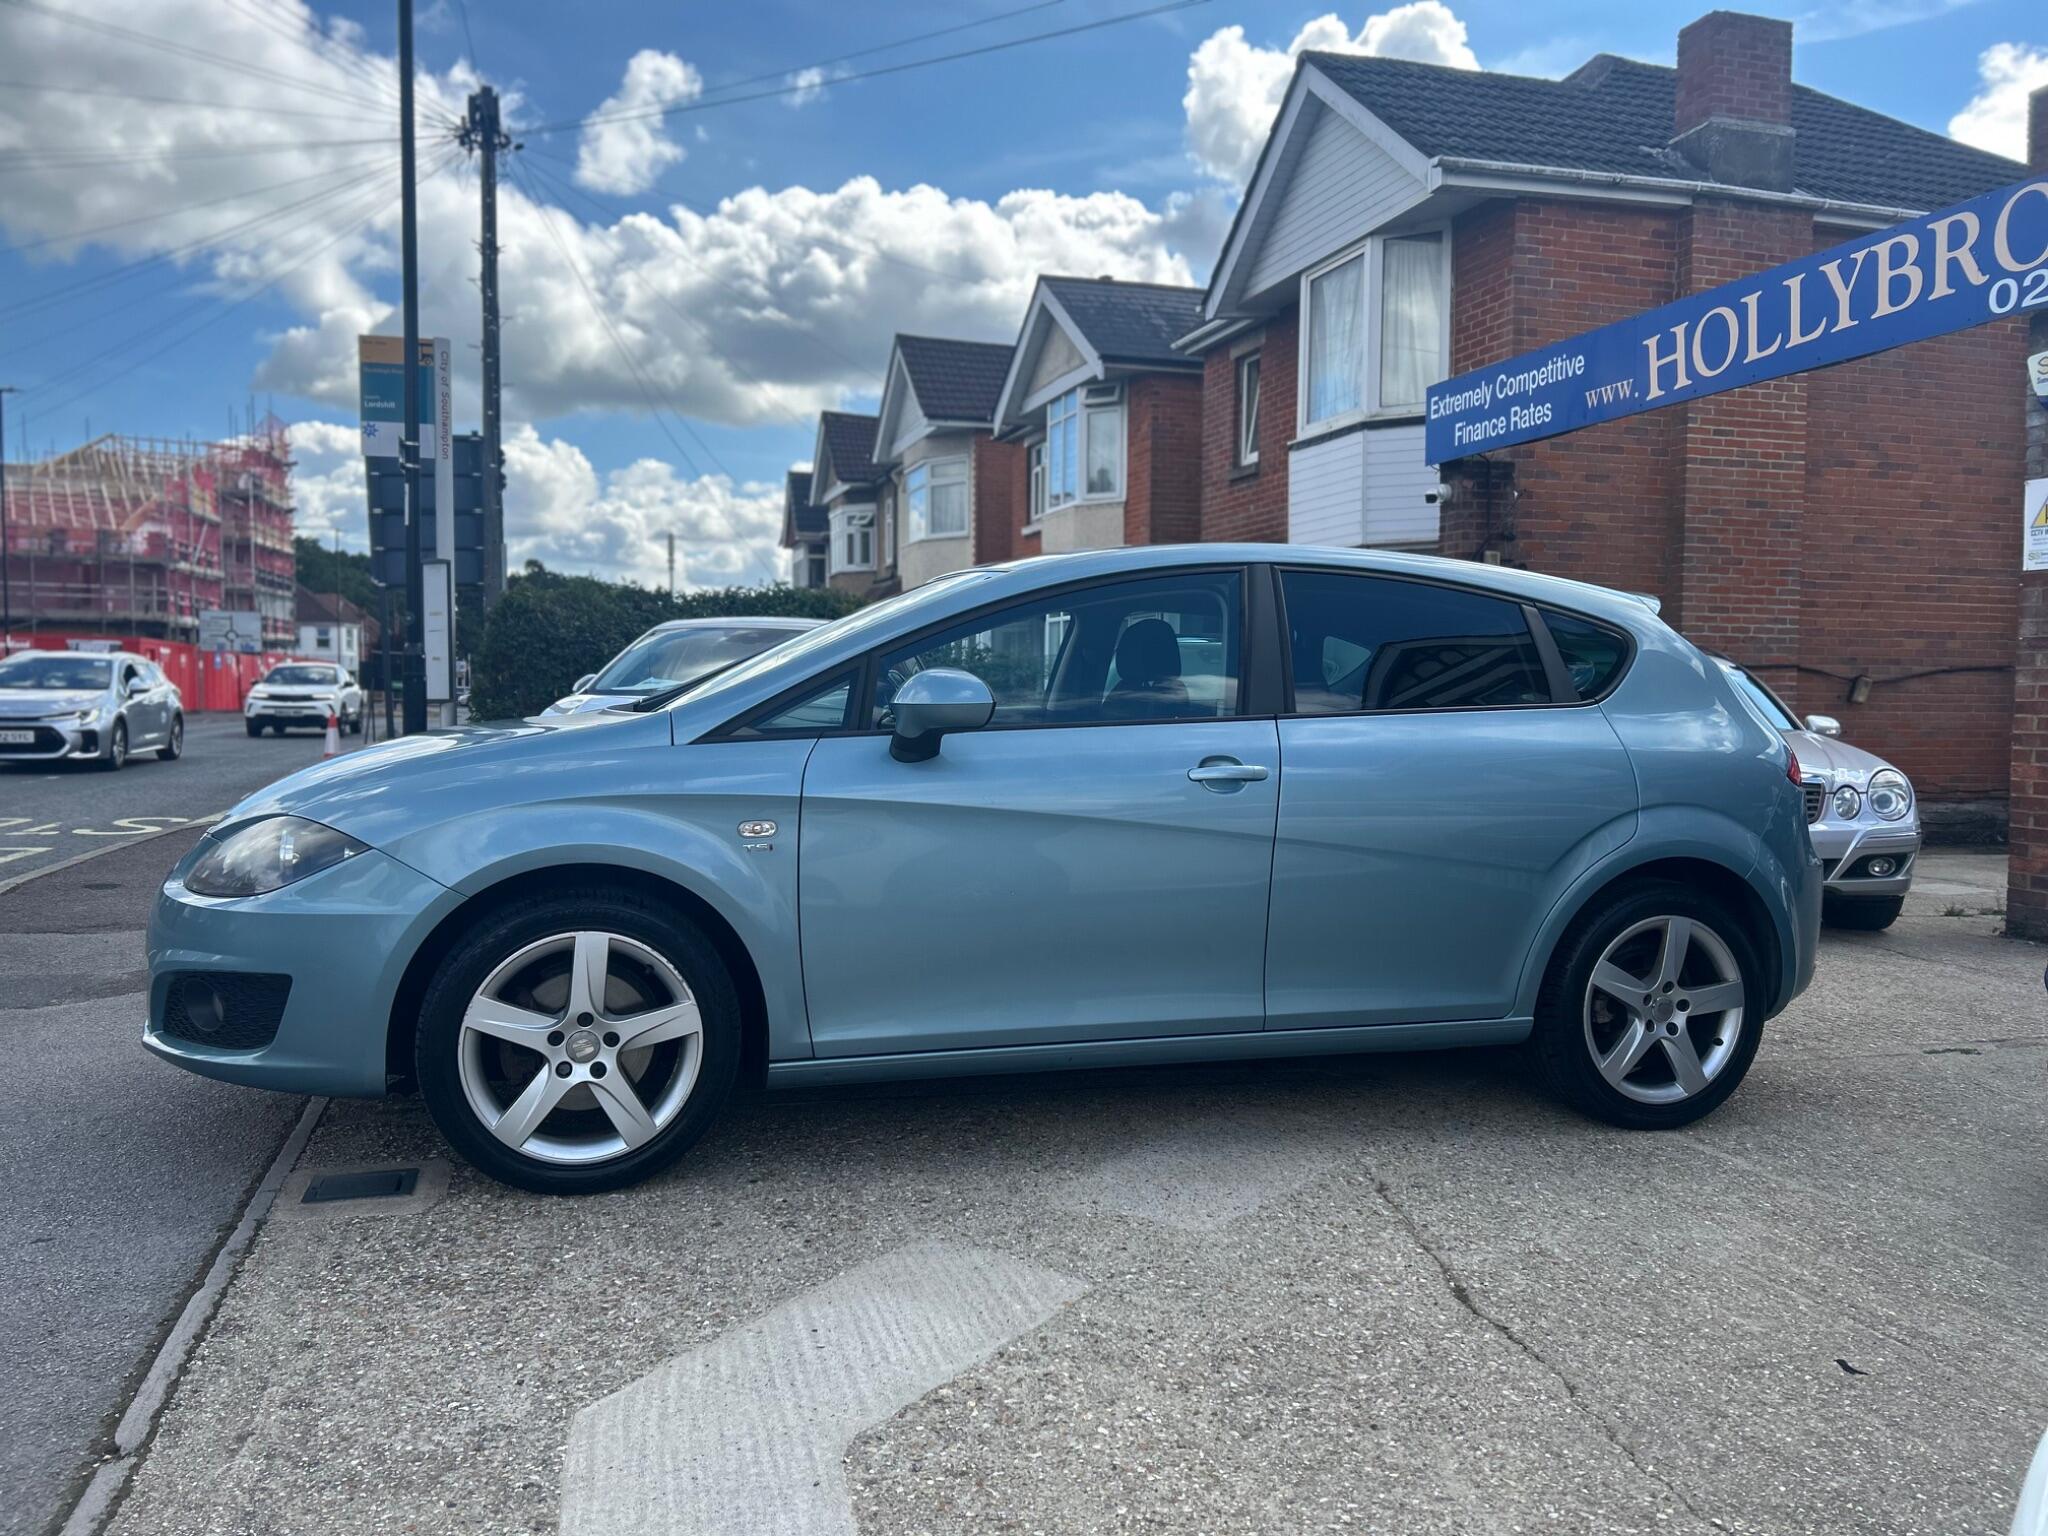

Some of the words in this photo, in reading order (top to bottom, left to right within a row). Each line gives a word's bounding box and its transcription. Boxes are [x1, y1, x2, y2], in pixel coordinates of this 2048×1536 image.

[1430, 380, 1493, 420] Extremely
[1496, 354, 1585, 399] Competitive
[440, 391, 449, 460] Southampton
[1454, 415, 1506, 446] Finance
[1510, 402, 1552, 432] Rates
